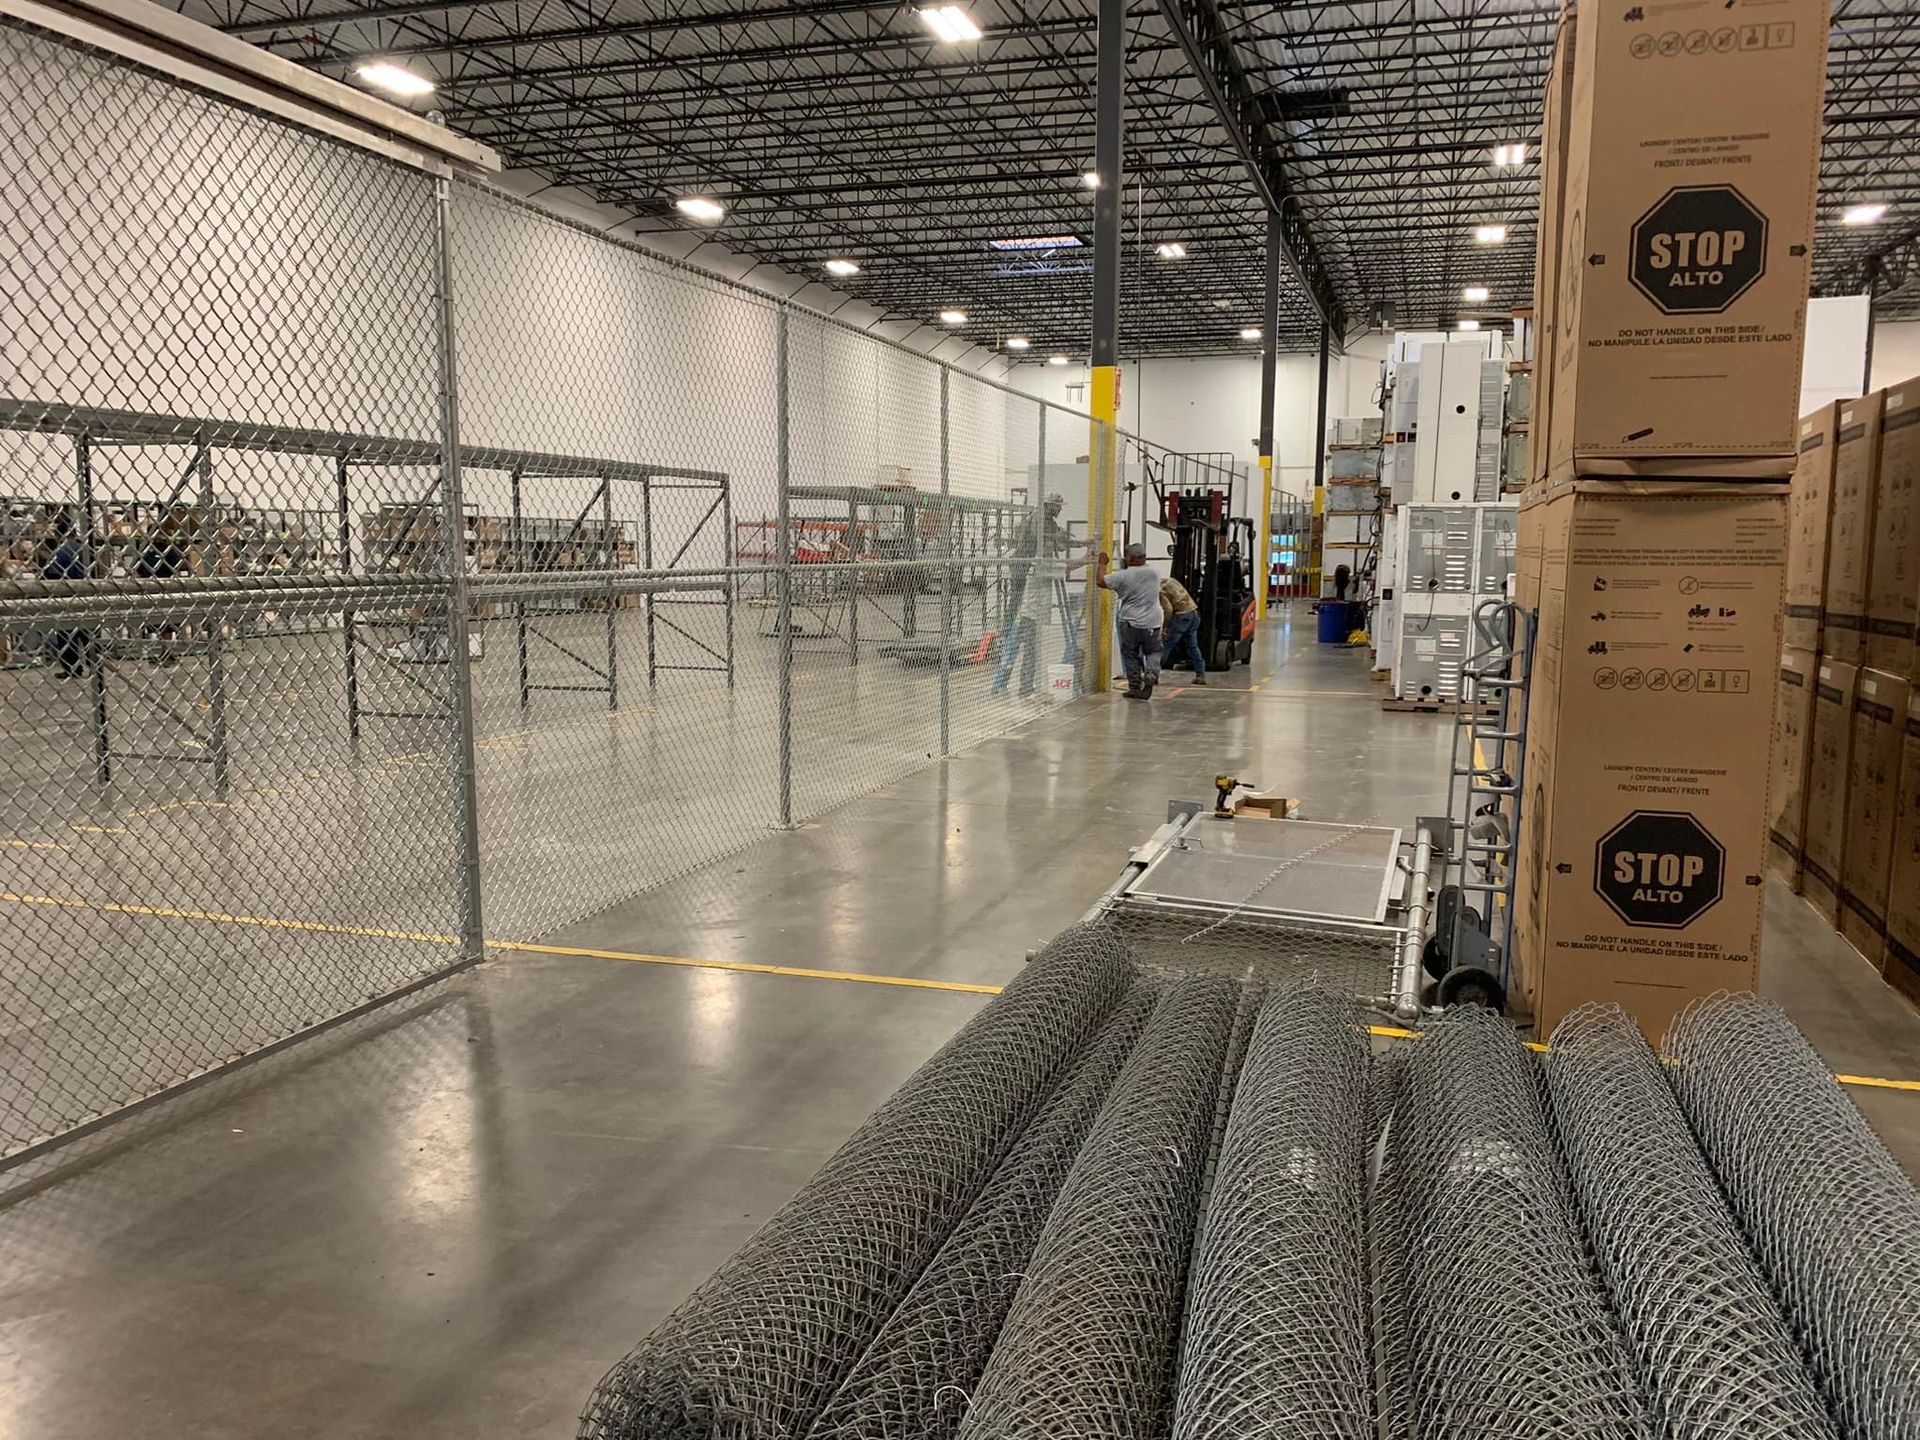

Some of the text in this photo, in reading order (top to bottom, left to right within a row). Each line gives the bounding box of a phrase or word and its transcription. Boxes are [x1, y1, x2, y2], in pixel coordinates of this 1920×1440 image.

[1650, 230, 1745, 269] STOP
[1669, 271, 1724, 287] ALTO
[1619, 329, 1633, 337] DO
[1635, 328, 1654, 337] NOT
[1657, 327, 1695, 336] HANDLE
[1697, 327, 1712, 335] ON
[1715, 326, 1735, 334] THIS
[1604, 338, 1650, 346] MANIPULE
[1653, 337, 1664, 345] LA
[1667, 336, 1702, 345] UNIDAD
[1704, 335, 1736, 344] DESDE
[1738, 334, 1763, 343] ESTE
[1766, 334, 1792, 342] LADO
[1614, 851, 1704, 887] STOP
[1632, 888, 1684, 904] ALTO
[1585, 934, 1598, 942] DO
[1600, 935, 1618, 944] NOT
[1620, 937, 1657, 947] HANDLE
[1658, 940, 1672, 948] ON
[1675, 941, 1695, 950] THIS
[1571, 942, 1614, 952] MANIPULE
[1617, 945, 1628, 953] LA
[1630, 946, 1664, 955] UNIDAD
[1665, 949, 1695, 958] DESDE
[1697, 952, 1720, 960] ESTE
[1723, 954, 1748, 962] LADO
